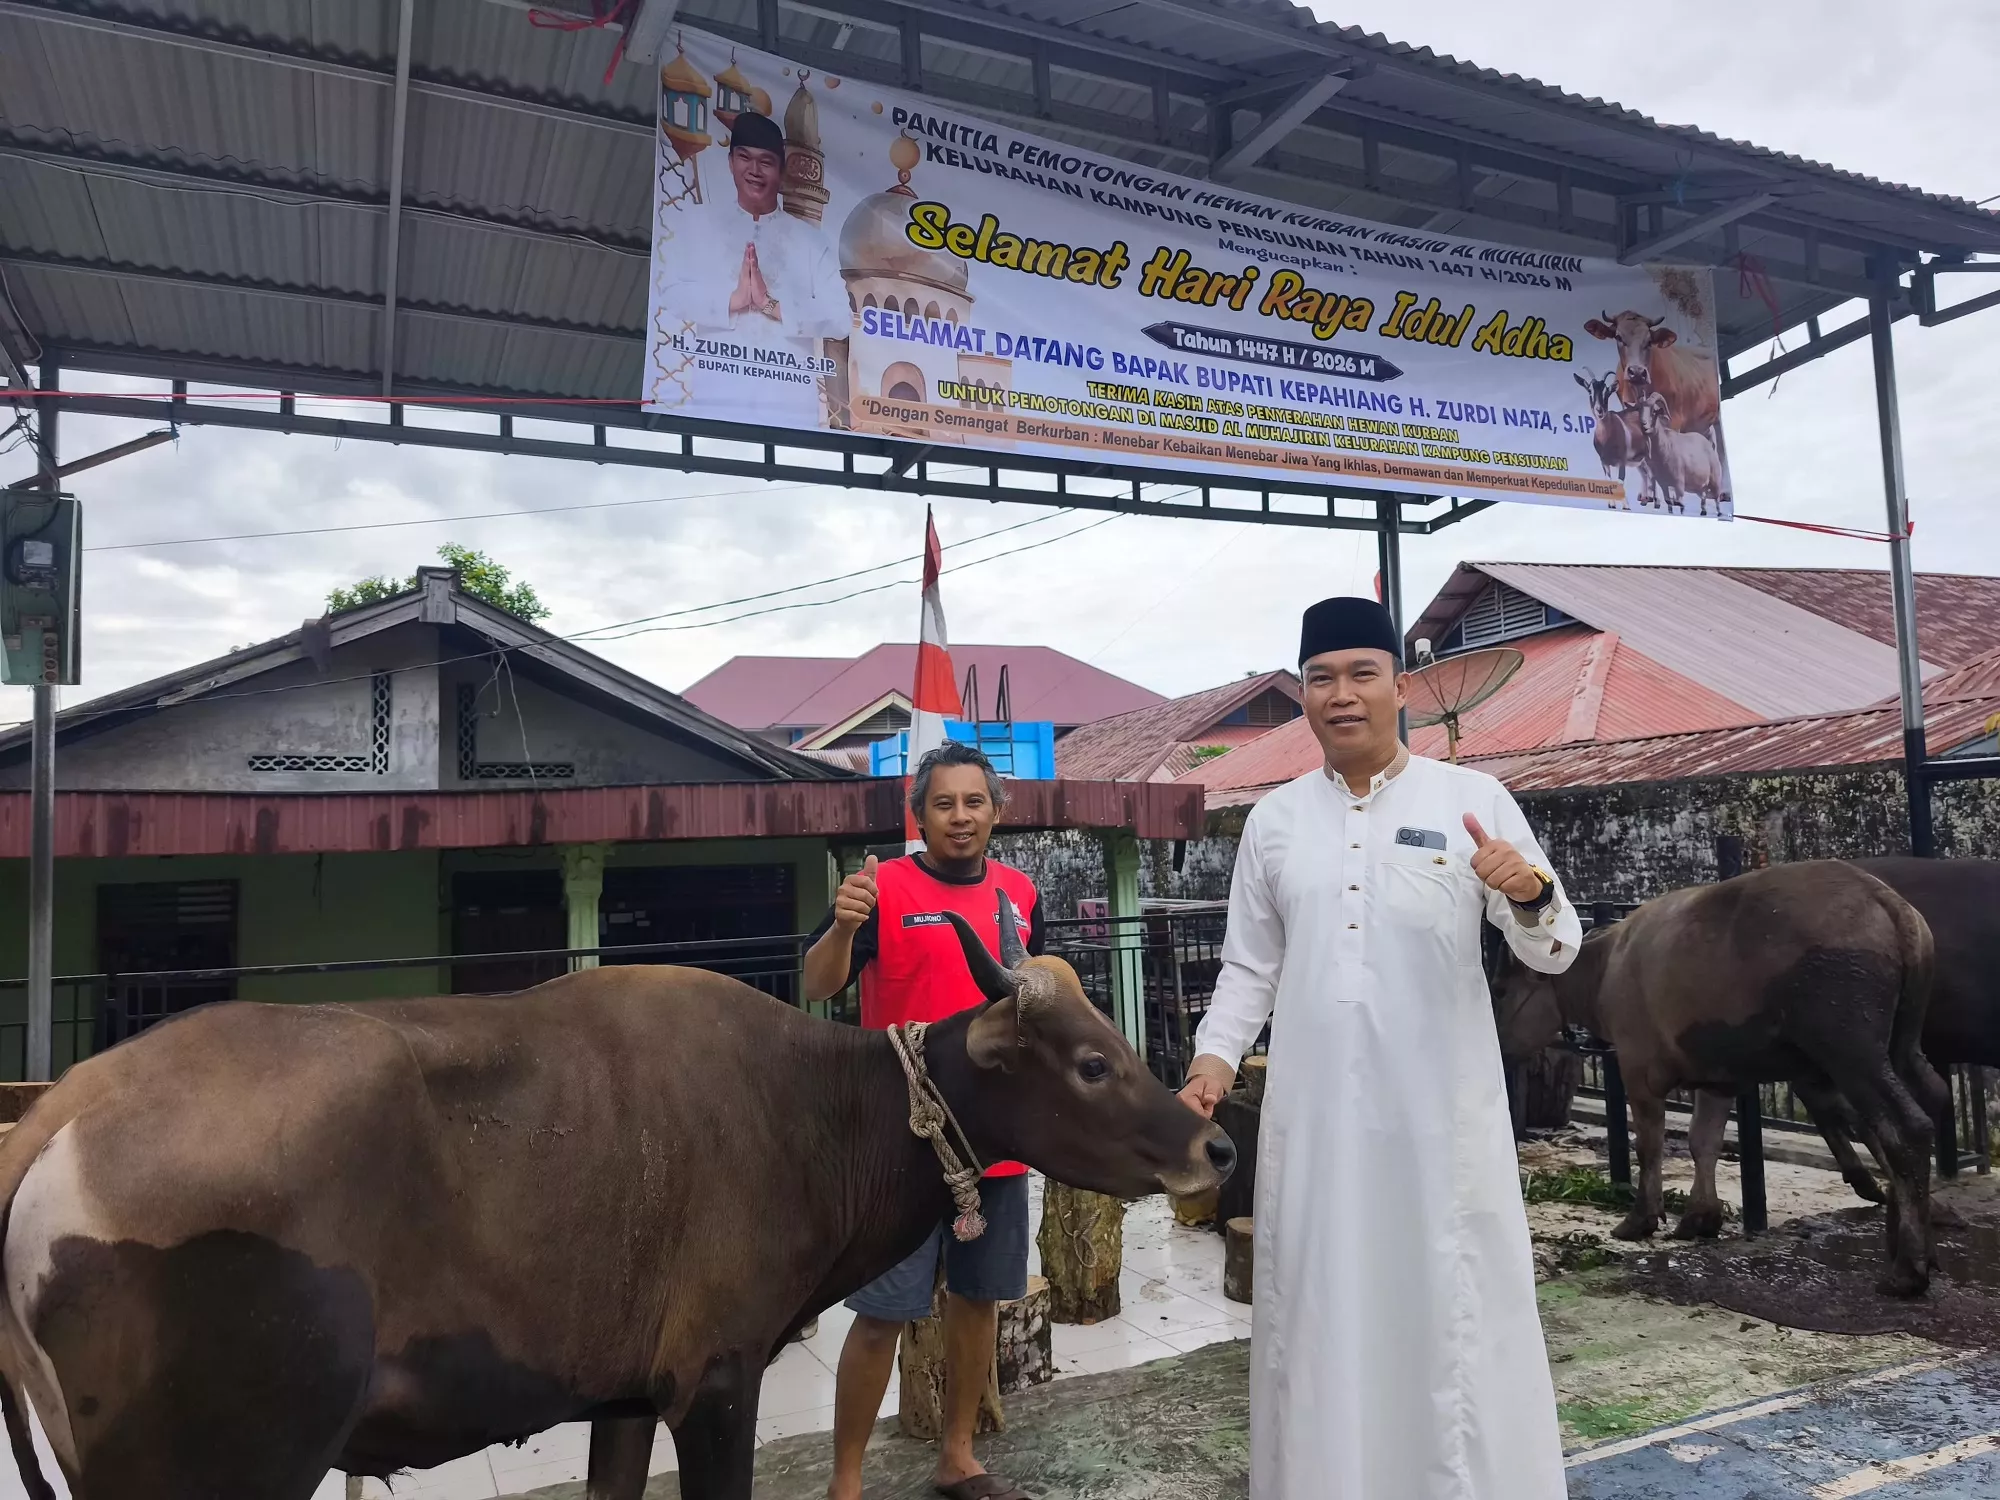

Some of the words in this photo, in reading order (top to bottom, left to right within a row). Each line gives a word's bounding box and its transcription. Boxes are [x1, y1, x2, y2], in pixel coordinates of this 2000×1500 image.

[892, 106, 999, 155] PANITIA
[1007, 140, 1192, 200] PEMOTONGAN
[1193, 191, 1282, 220] HEWAN
[1282, 212, 1375, 240] KURBAN
[1373, 231, 1450, 253] MASJID
[1450, 244, 1476, 258] AL
[1479, 248, 1583, 273] MUHAJIRIN
[926, 141, 1084, 199] KELURAHAN
[1090, 188, 1212, 230] KAMPUNG
[1217, 219, 1347, 258] PENSIUNAN
[1350, 246, 1424, 271] TAHUN
[1429, 259, 1473, 278] 1447
[1480, 266, 1551, 288] H/2026
[1555, 276, 1573, 292] M
[905, 201, 1130, 290] Selamat
[1138, 245, 1260, 311] Hari
[1258, 268, 1375, 341] Raya
[1379, 290, 1476, 348] Idul
[1472, 310, 1573, 362] Adha
[1218, 238, 1344, 273] Mengucapkan
[673, 334, 689, 350] H.
[695, 339, 748, 360] ZURDI
[753, 348, 802, 369] NATA,
[806, 357, 836, 373] S.IP
[698, 359, 739, 375] BUPATI
[743, 366, 811, 385] KEPAHIANG
[862, 309, 986, 353] SELAMAT
[996, 331, 1105, 371] DATANG
[1112, 351, 1190, 386] BAPAK
[1196, 365, 1273, 397] BUPATI
[1280, 379, 1403, 415] KEPAHIANG
[1410, 397, 1430, 418] H.
[1436, 400, 1497, 425] ZURDI
[1503, 408, 1557, 435] NATA,
[1563, 415, 1595, 434] S.IP
[1173, 327, 1232, 354] Tahun
[1235, 339, 1279, 361] 1447
[1282, 348, 1295, 364] H
[1299, 349, 1308, 365] /
[1312, 350, 1357, 372] 2026
[1360, 359, 1376, 376] M
[934, 409, 1008, 434] Semangat
[1016, 420, 1089, 442] Berkurban
[1103, 431, 1160, 449] Menebar
[1163, 438, 1222, 457] Kebaikan
[1226, 446, 1278, 463] Menebar
[1281, 453, 1308, 466] Jiwa
[1311, 456, 1340, 471] Yang
[1344, 458, 1381, 476] Ikhlas,
[1383, 463, 1442, 480] Dermawan
[1444, 468, 1464, 482] dan
[1466, 470, 1529, 488] Memperkuat
[1531, 477, 1586, 493] Kepedulian
[938, 380, 1006, 407] UNTUK
[1008, 390, 1133, 423] PEMOTONGAN
[1137, 409, 1156, 427] DI
[1160, 412, 1219, 434] MASJID
[1222, 421, 1242, 437] AL
[1246, 425, 1331, 447] MUHAJIRIN
[1333, 434, 1420, 456] KELURAHAN
[1422, 443, 1490, 464] KAMPUNG
[1493, 451, 1569, 471] PENSIUNAN
[1086, 381, 1150, 406] TERIMA
[1155, 389, 1203, 412] KASIH
[1206, 399, 1244, 417] ATAS
[1247, 404, 1344, 430] PENYERAHAN
[1347, 416, 1399, 437] HEWAN
[1402, 423, 1460, 444] KURBAN
